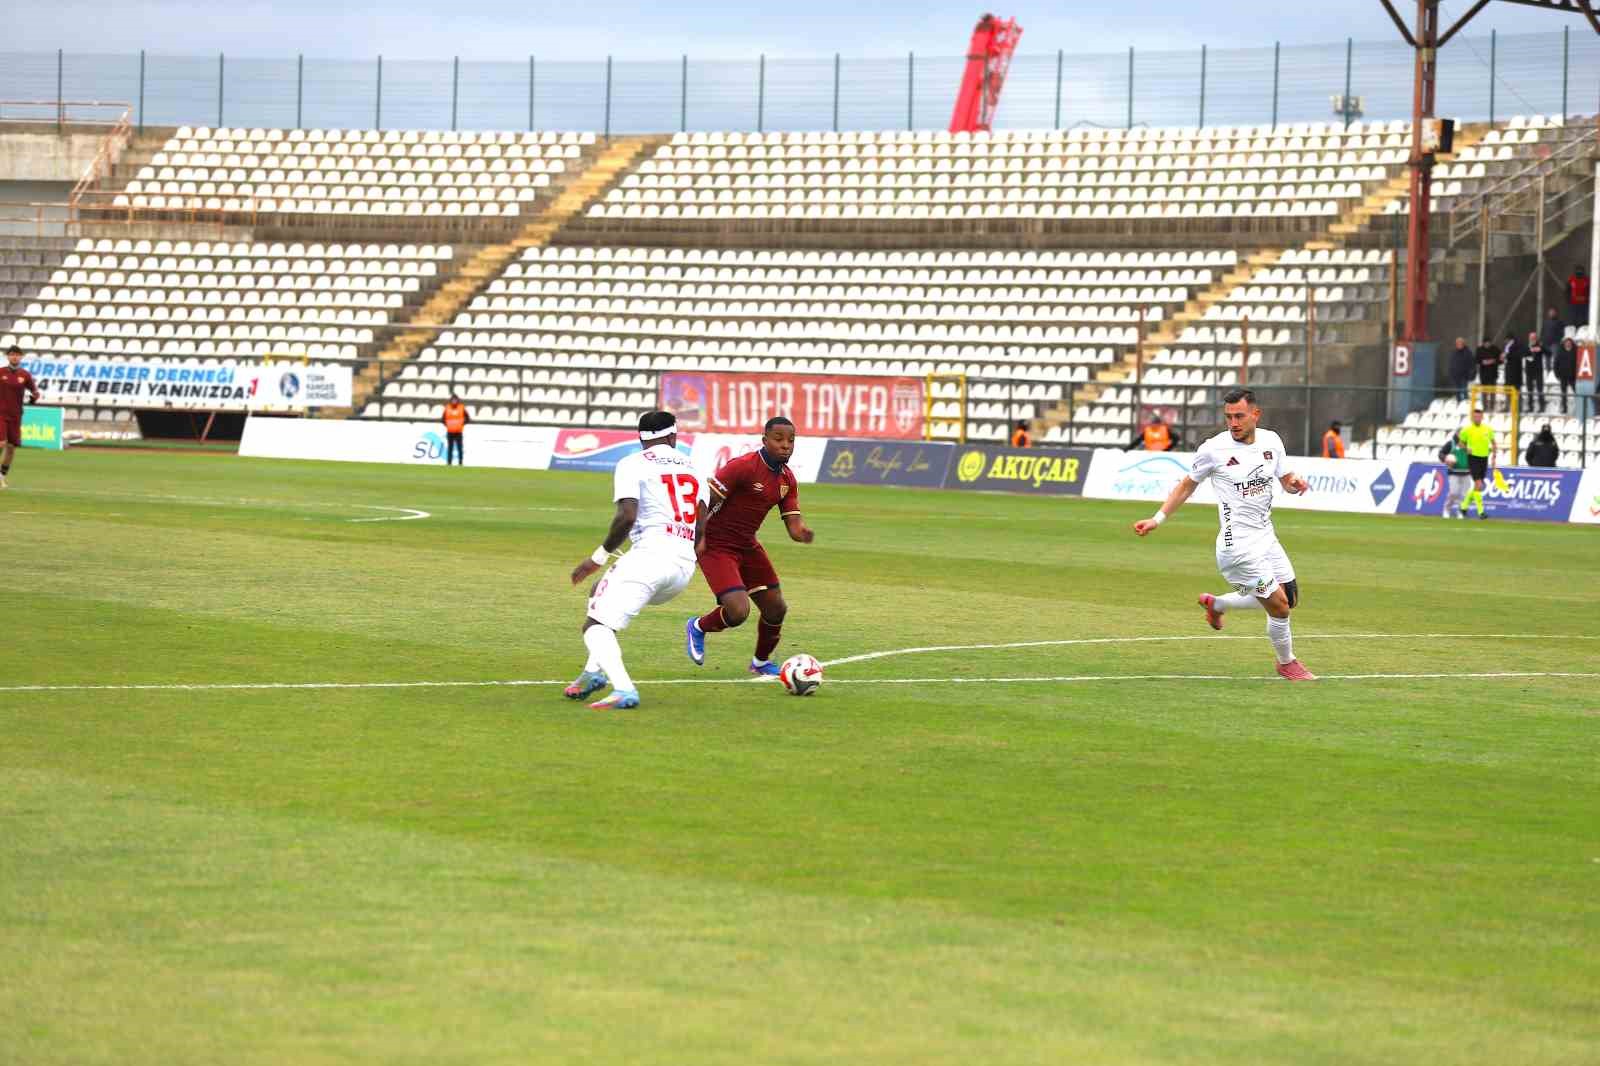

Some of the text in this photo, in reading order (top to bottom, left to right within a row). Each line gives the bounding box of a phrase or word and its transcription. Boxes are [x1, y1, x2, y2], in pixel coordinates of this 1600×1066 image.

[73, 364, 150, 380] KANSER
[1395, 346, 1408, 373] B
[1578, 350, 1593, 376] A
[803, 384, 888, 431] TAYFA
[987, 455, 1079, 488] AKUÇAR
[660, 473, 700, 524] 13
